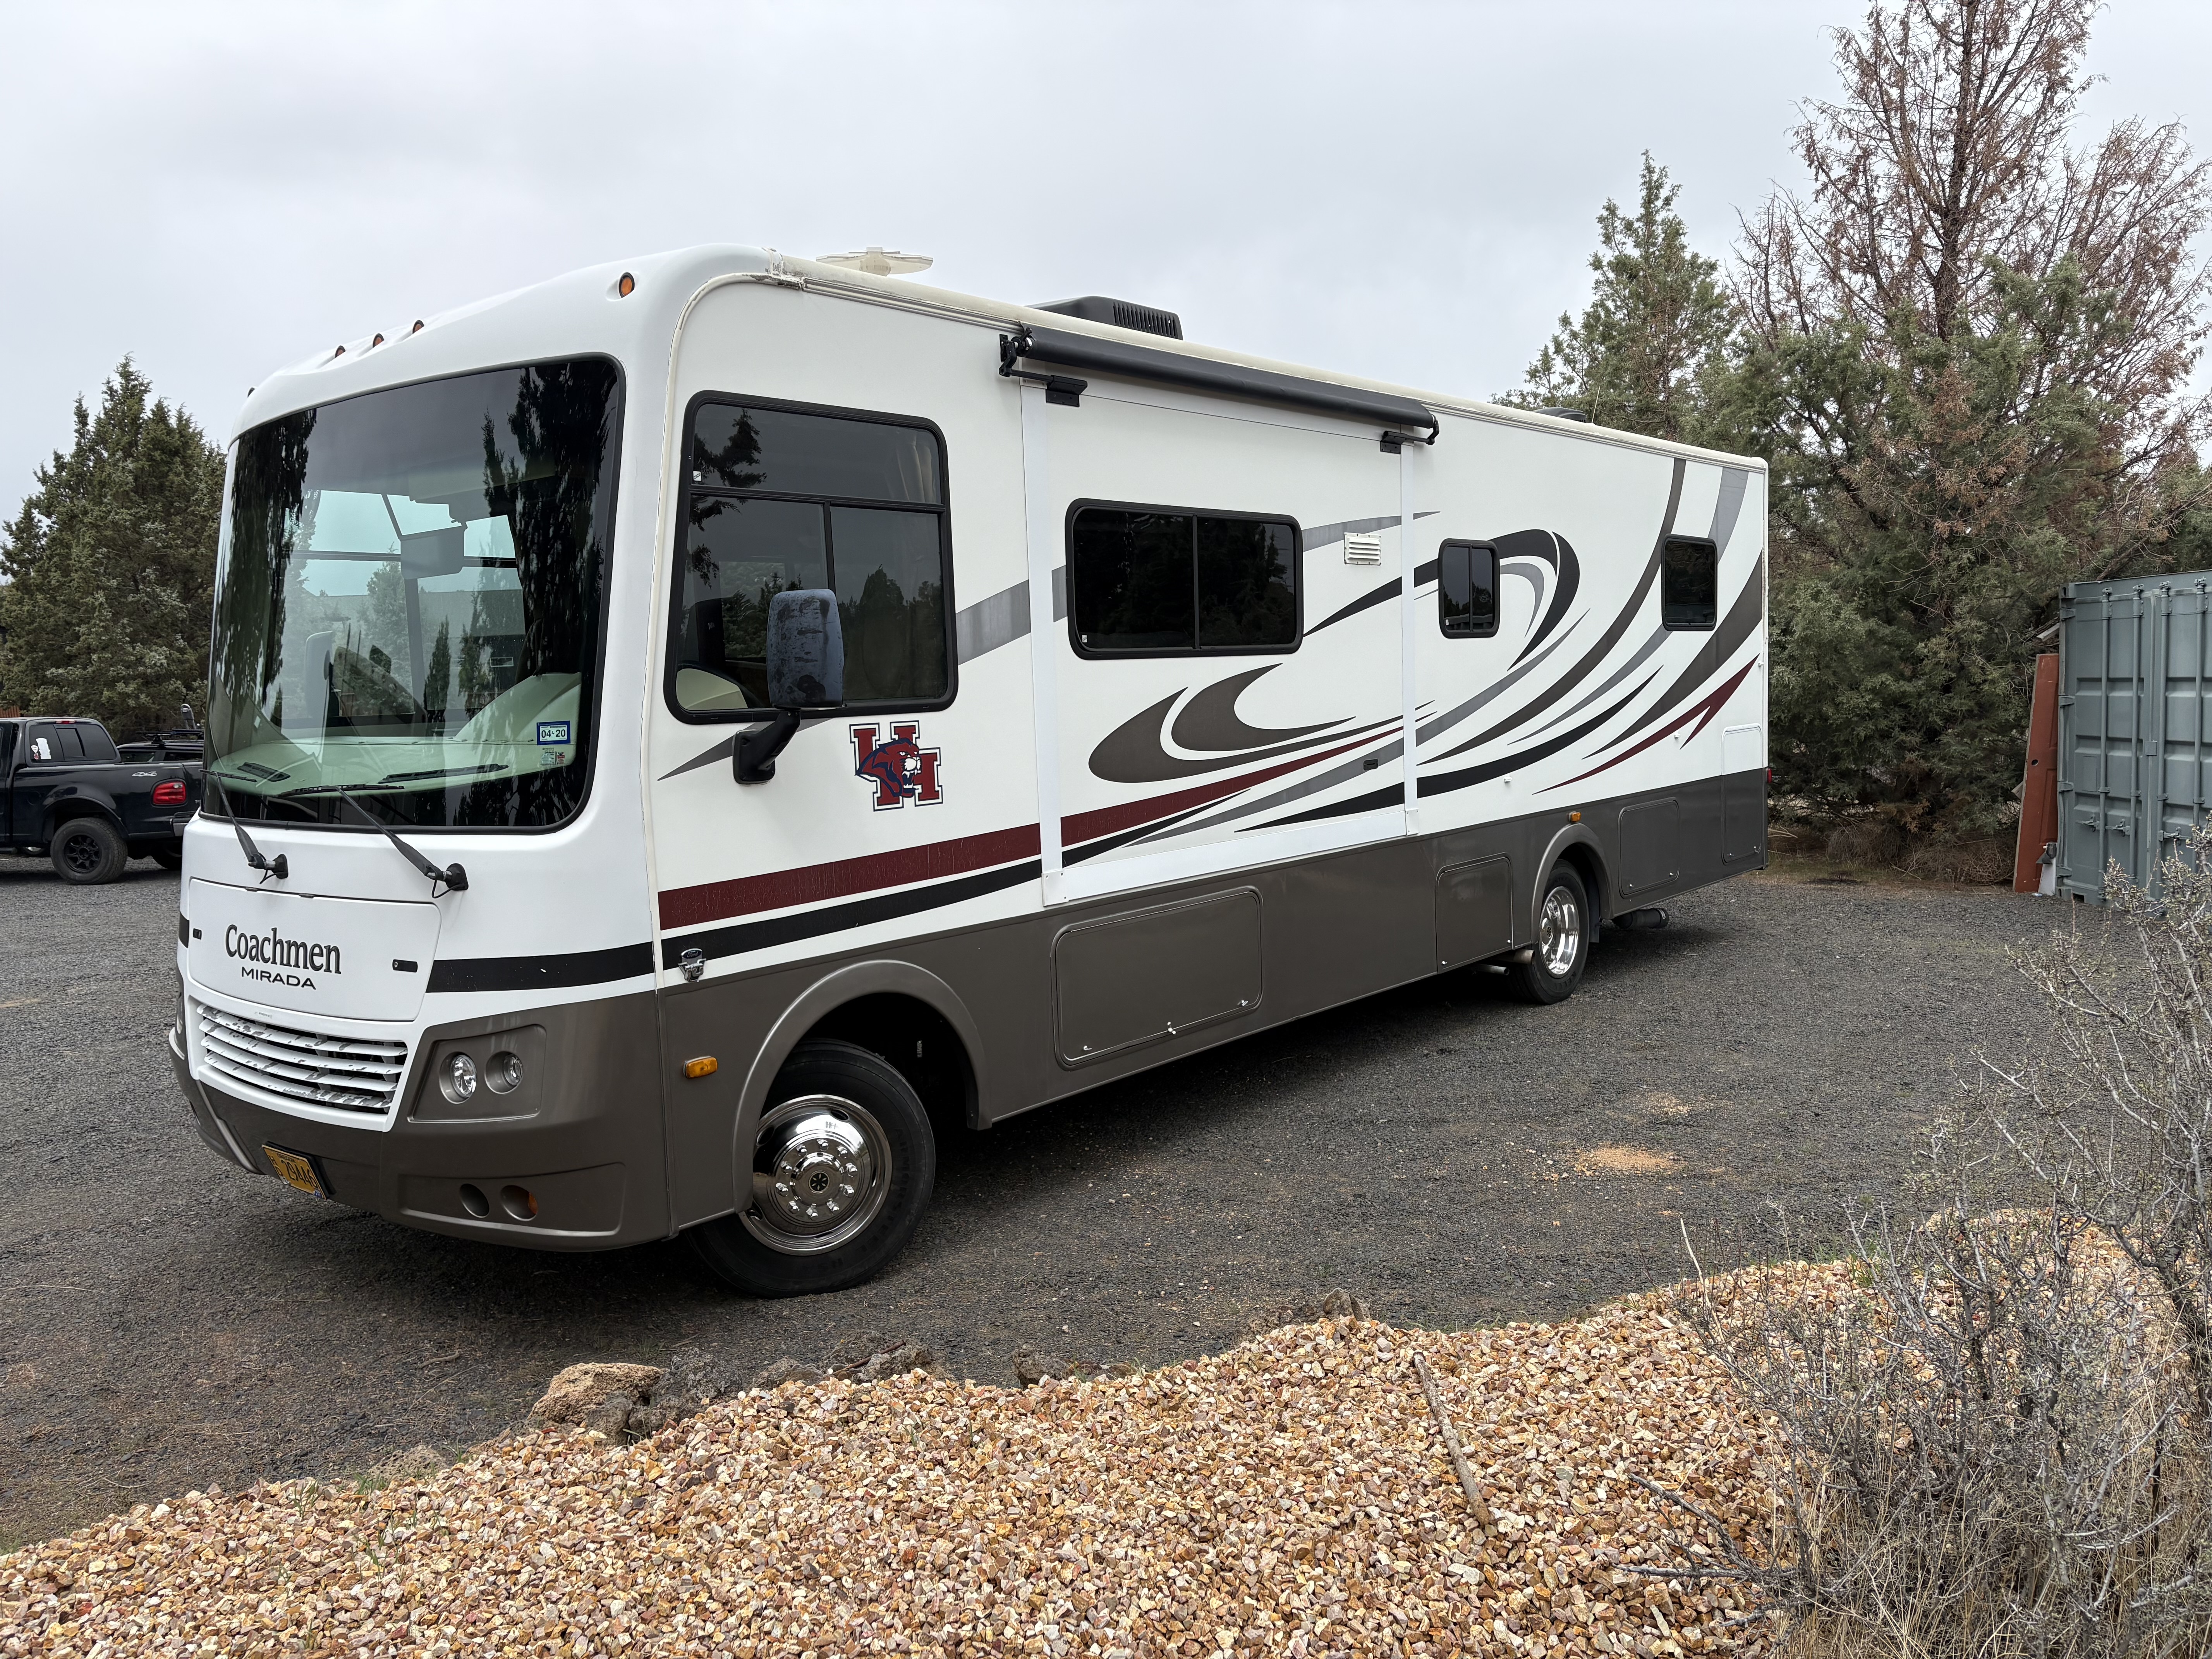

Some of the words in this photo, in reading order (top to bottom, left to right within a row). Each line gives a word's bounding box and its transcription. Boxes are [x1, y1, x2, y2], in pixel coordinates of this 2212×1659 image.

[225, 924, 341, 974] Coachmen
[242, 966, 316, 990] MIRADA
[281, 1159, 318, 1188] 29446
